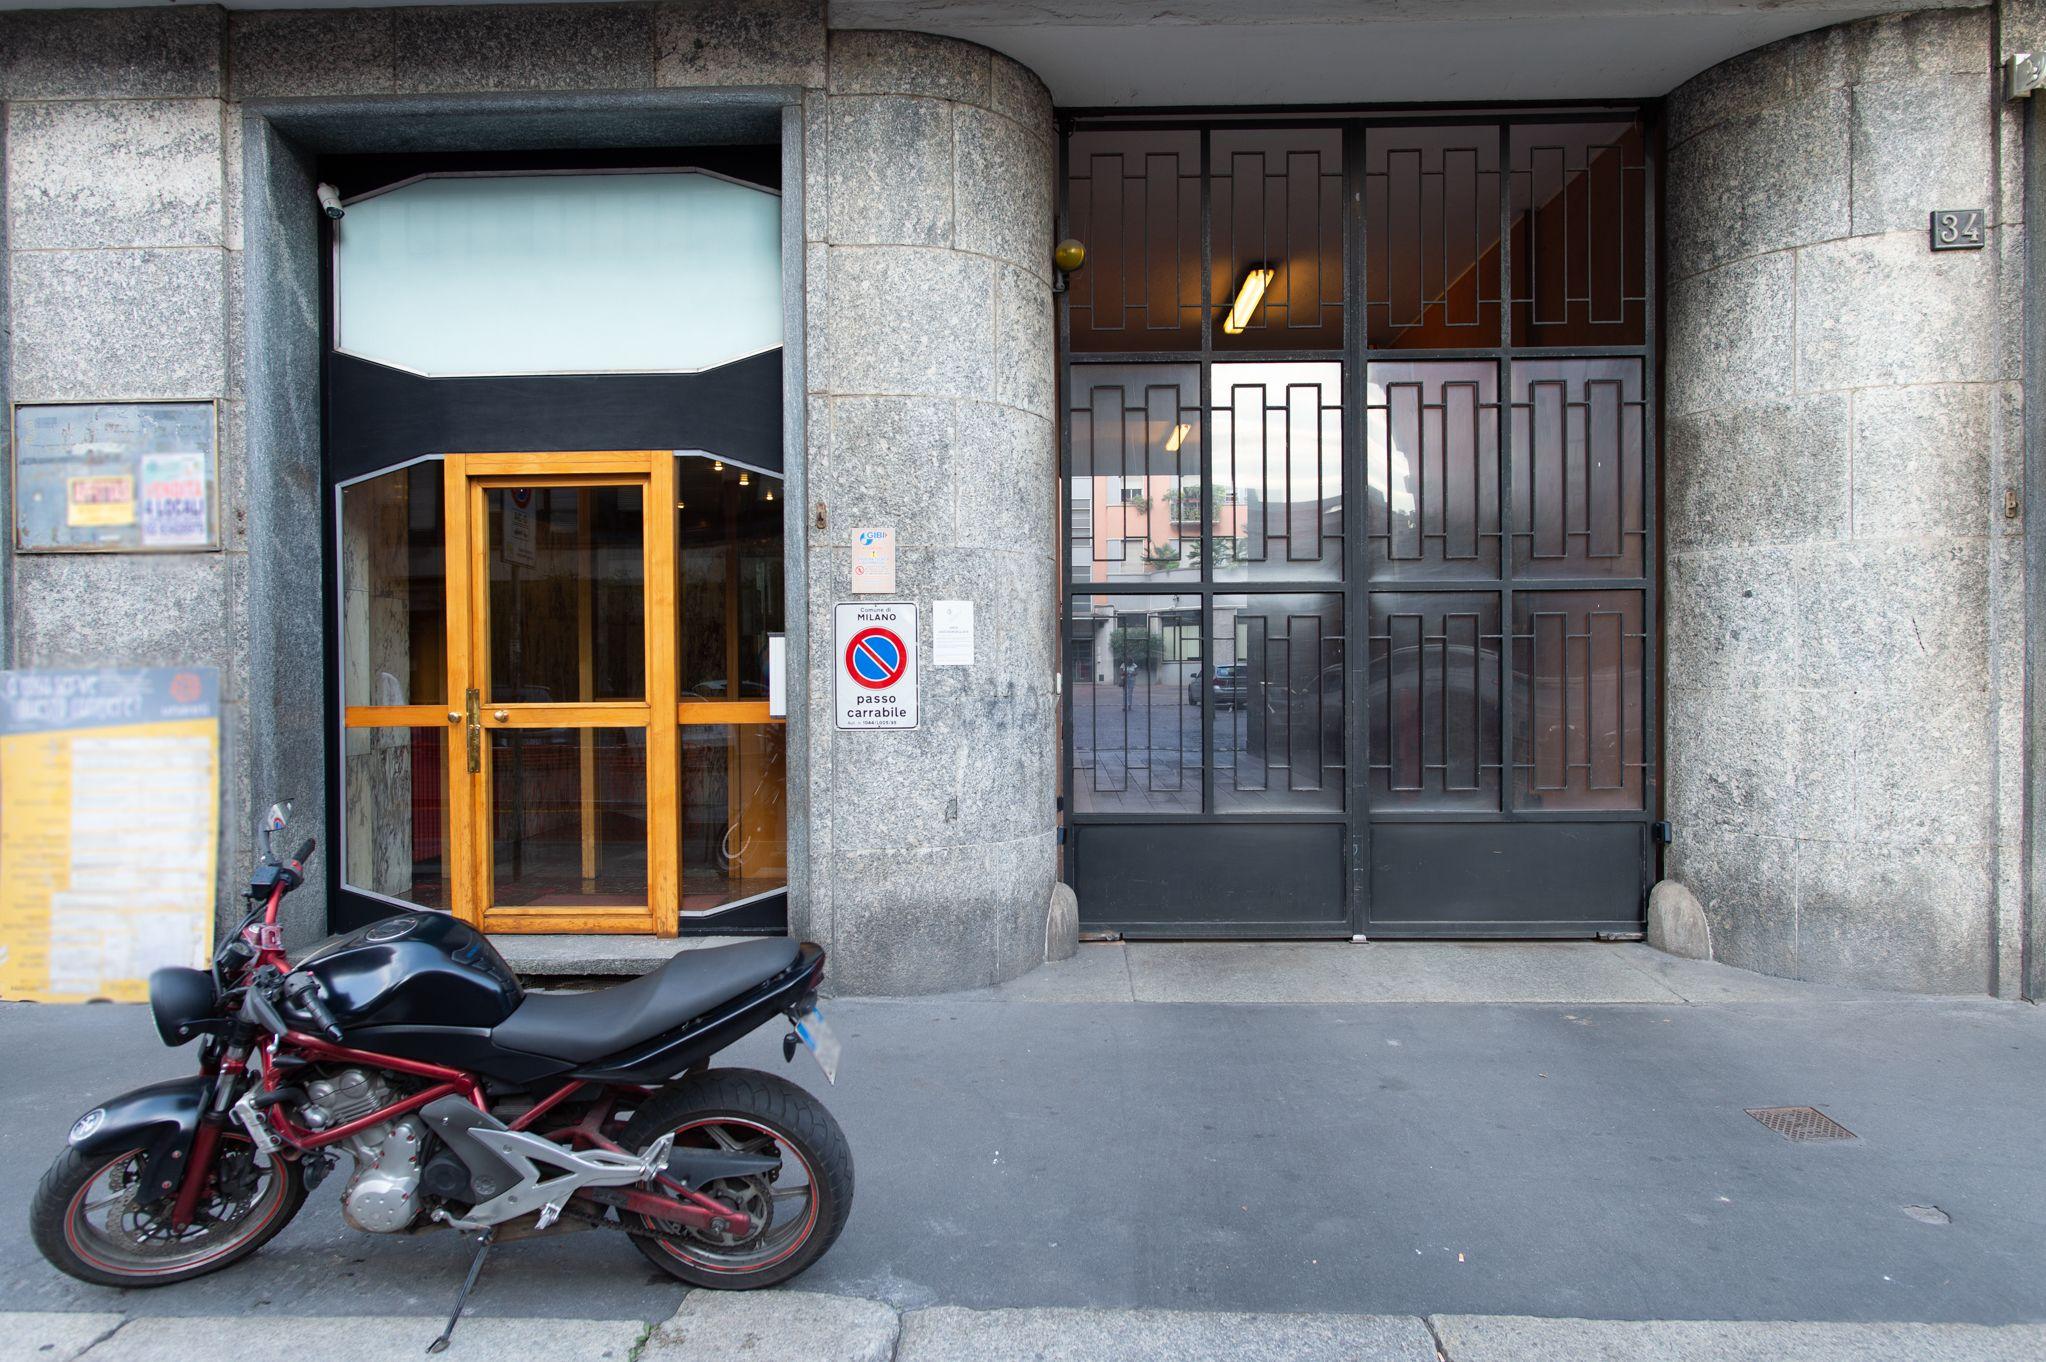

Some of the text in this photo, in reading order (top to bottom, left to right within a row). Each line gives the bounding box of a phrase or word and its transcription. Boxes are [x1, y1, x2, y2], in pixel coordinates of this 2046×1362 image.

[1941, 213, 1980, 243] 34
[857, 613, 897, 621] MILANO
[857, 695, 897, 706] passo
[847, 707, 907, 718] carrabile
